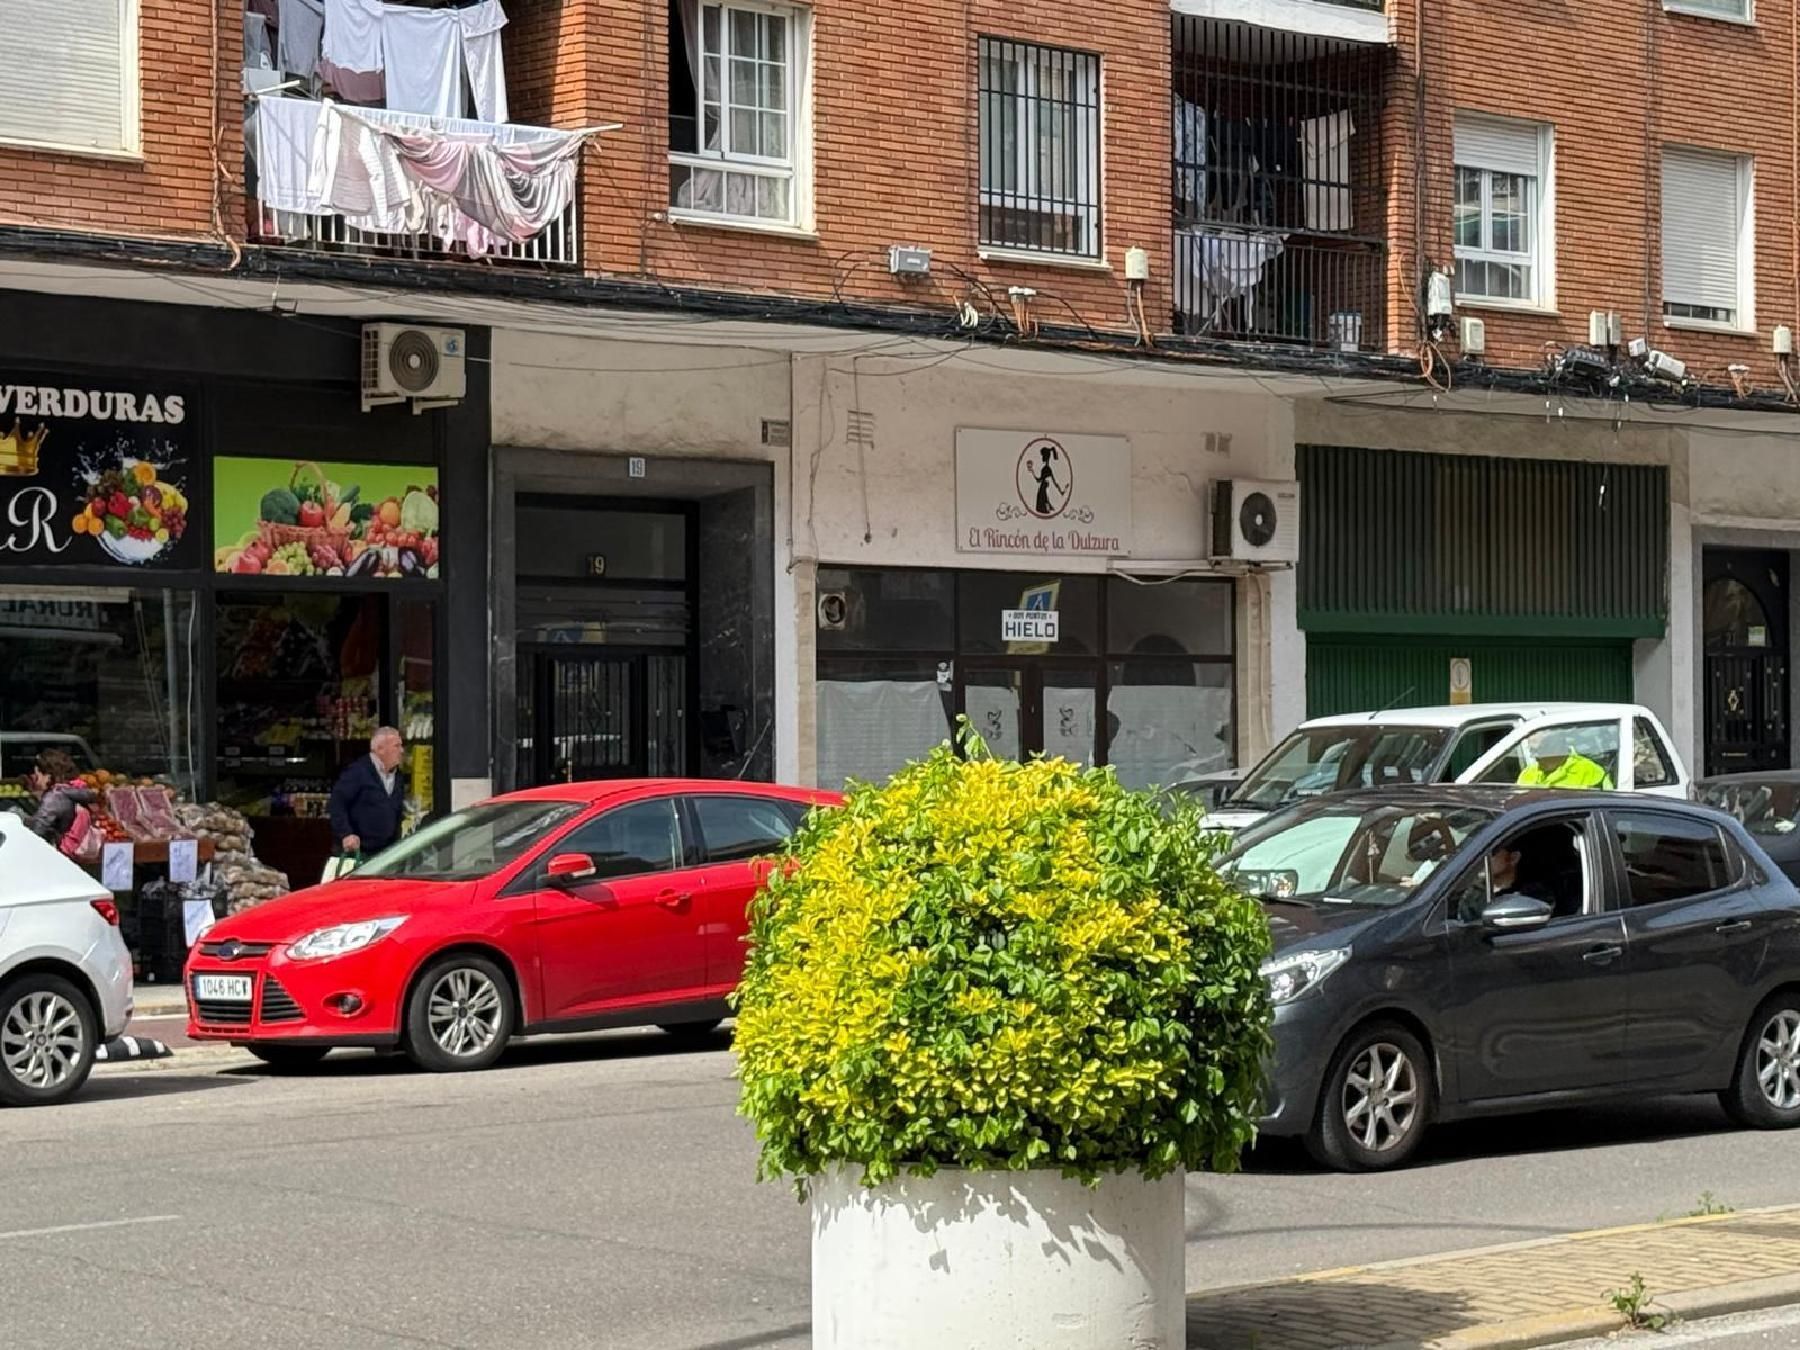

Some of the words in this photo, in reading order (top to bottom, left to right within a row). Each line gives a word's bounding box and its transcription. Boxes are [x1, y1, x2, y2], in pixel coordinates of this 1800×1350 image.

[969, 527, 981, 547] El
[983, 527, 1030, 549] Rincón
[1033, 530, 1049, 551] de
[1052, 531, 1064, 549] la
[1068, 530, 1119, 551] Dulzura
[1005, 621, 1055, 638] HIELO
